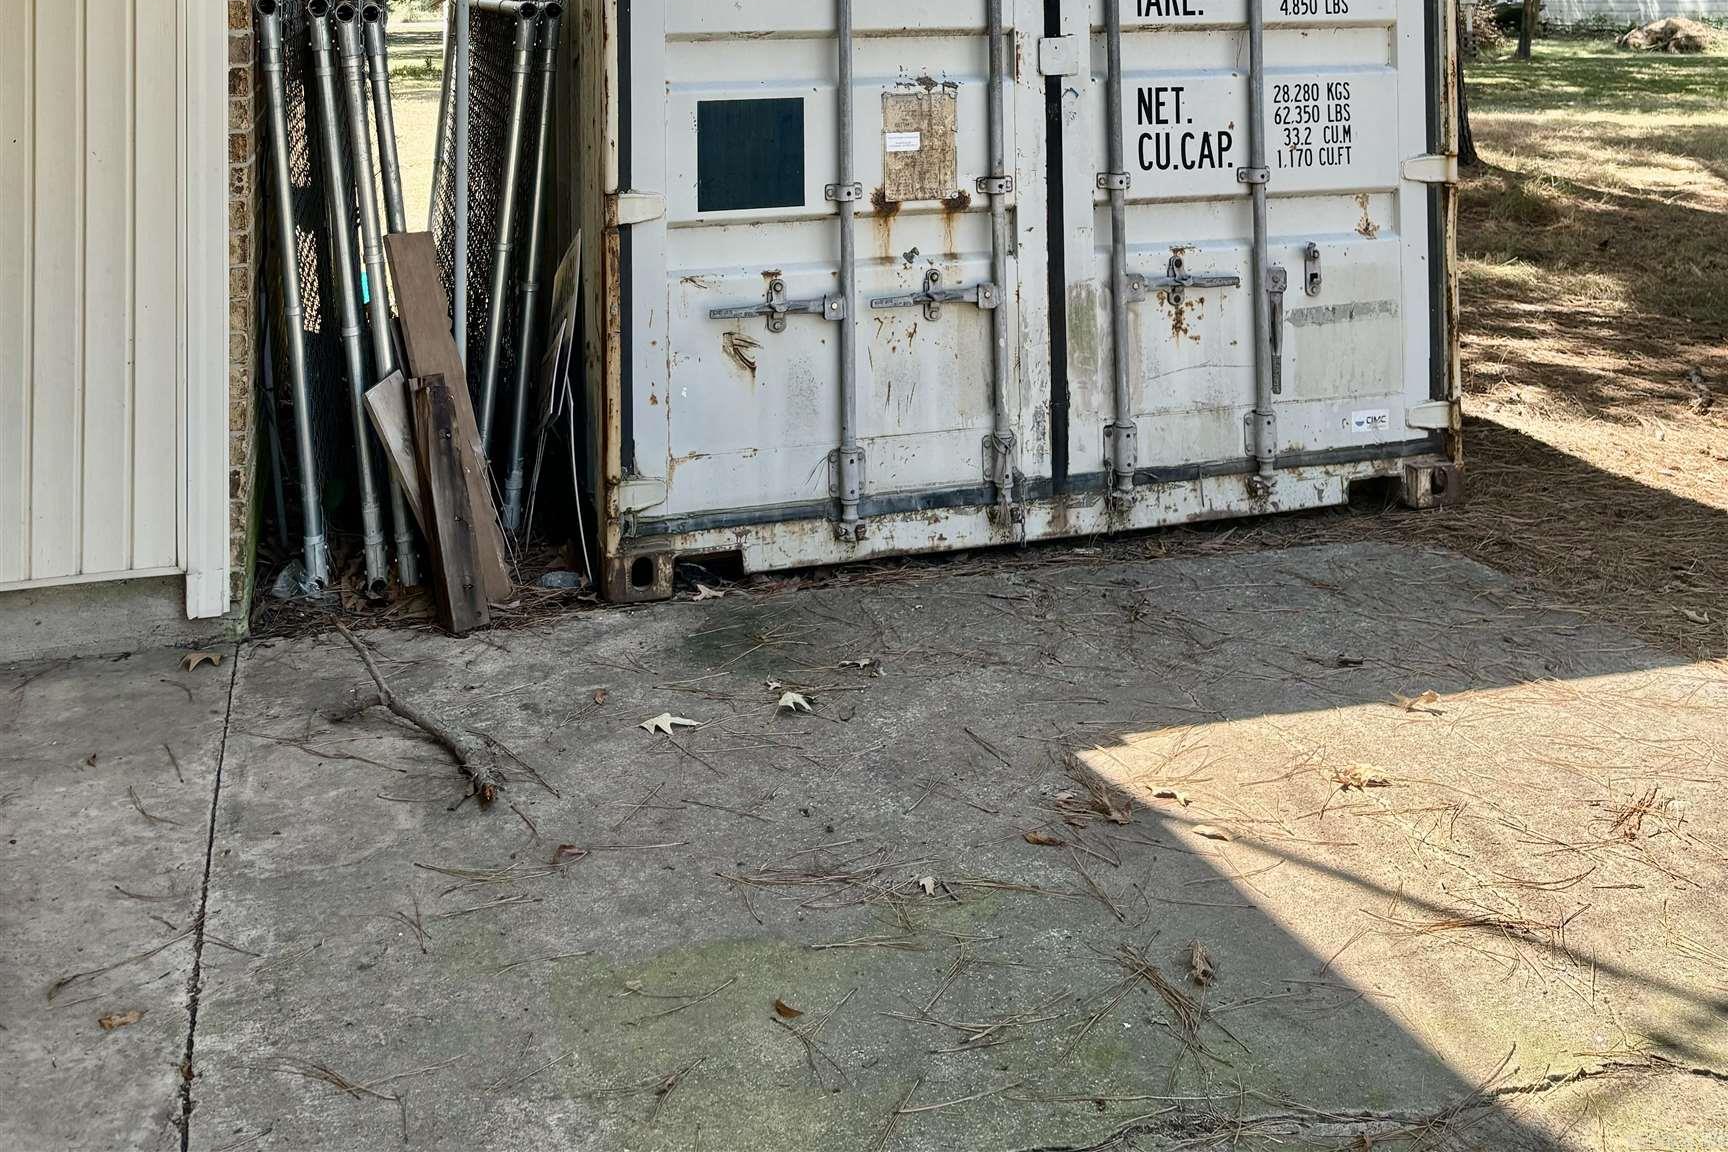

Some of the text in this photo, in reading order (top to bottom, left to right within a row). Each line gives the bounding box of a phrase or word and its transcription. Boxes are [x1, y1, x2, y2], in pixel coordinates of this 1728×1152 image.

[1327, 82, 1350, 100] KGS
[1137, 87, 1192, 125] NET.
[1328, 104, 1350, 122] LBS
[1284, 125, 1351, 146] 33.2 CU.M
[1138, 131, 1232, 170] CU.CAP.
[1319, 147, 1351, 165] CU.FT
[1366, 415, 1386, 424] CIMC
